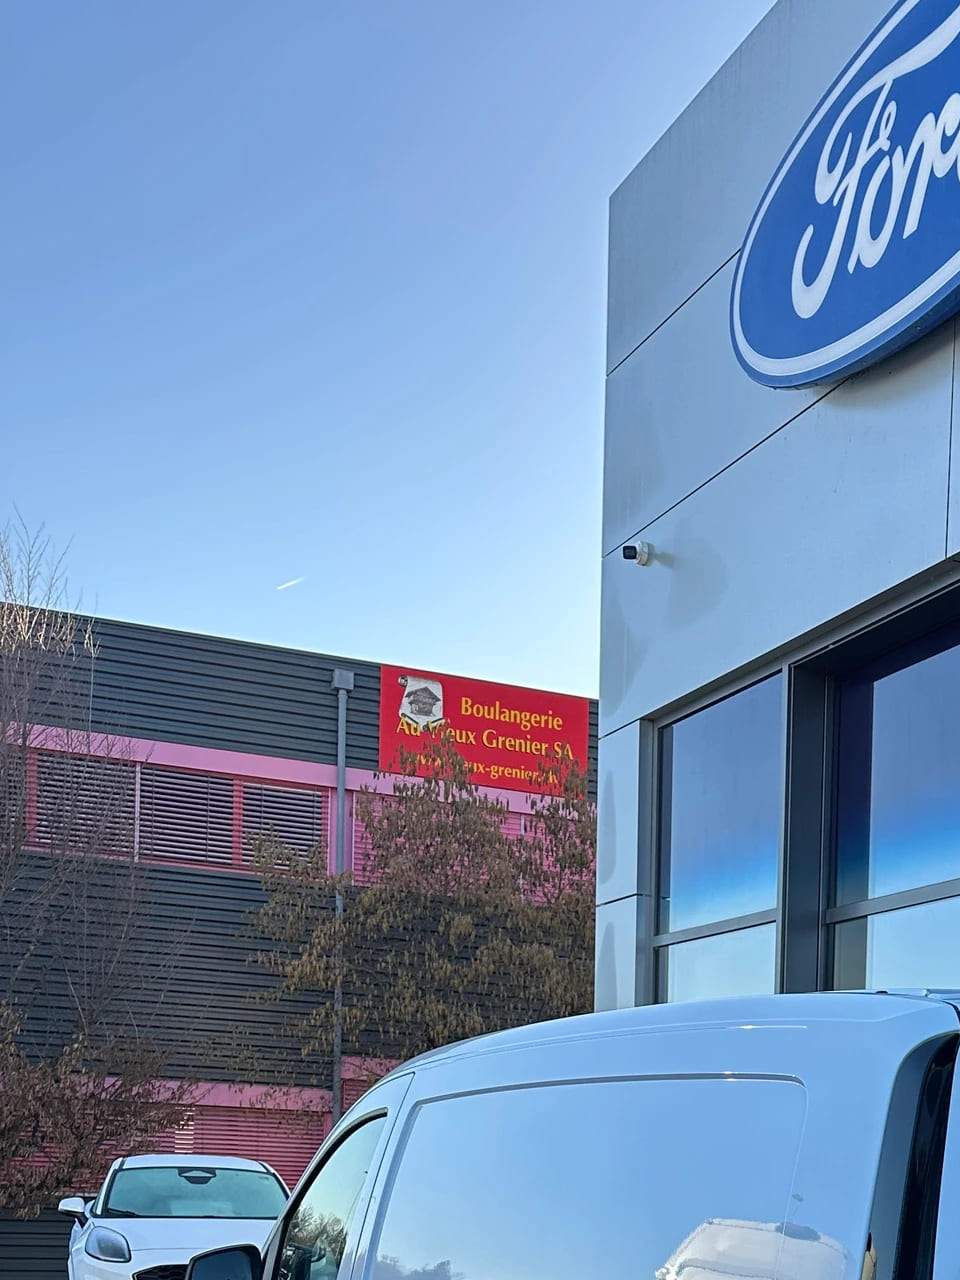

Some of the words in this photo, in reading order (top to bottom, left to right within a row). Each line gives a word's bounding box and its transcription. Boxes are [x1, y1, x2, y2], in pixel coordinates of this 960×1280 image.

[460, 696, 564, 731] Boulangerie
[396, 717, 421, 737] Au
[482, 729, 548, 756] Grenier
[554, 741, 574, 760] SA
